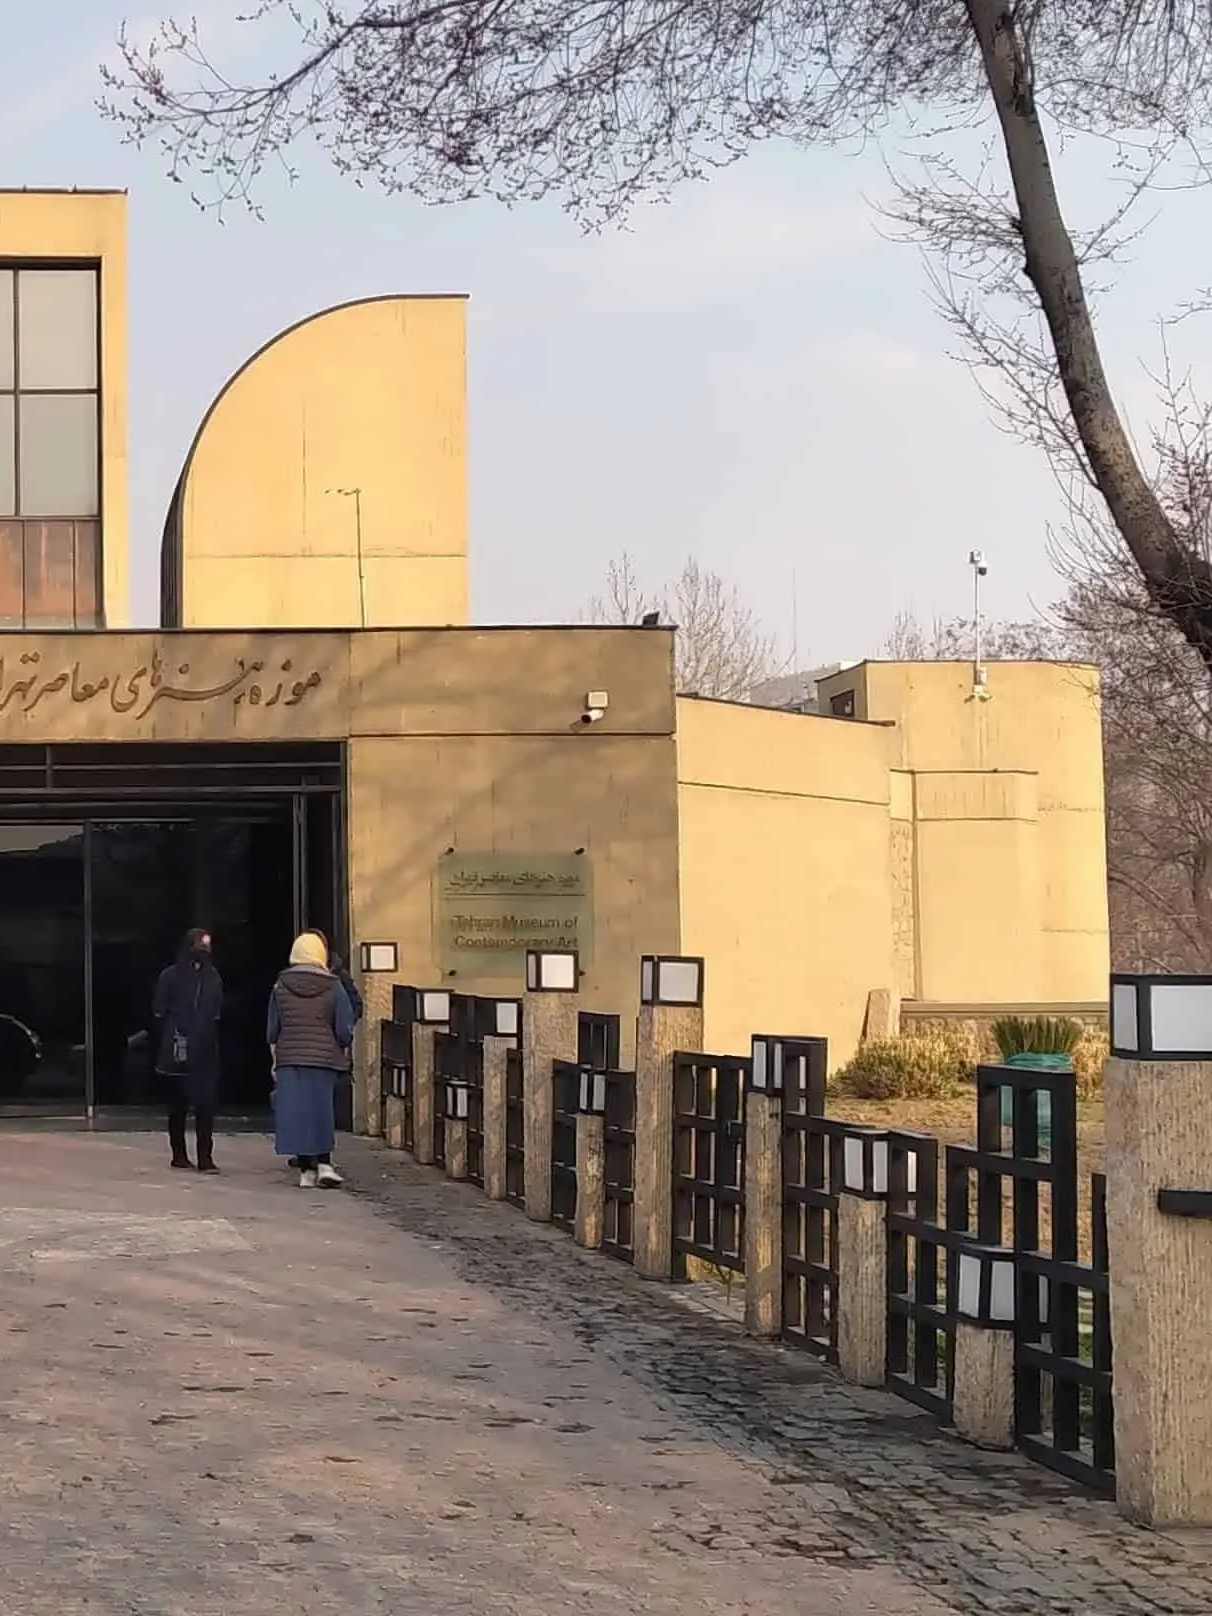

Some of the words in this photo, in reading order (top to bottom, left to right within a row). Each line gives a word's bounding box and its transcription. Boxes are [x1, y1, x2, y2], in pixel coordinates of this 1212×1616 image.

[23, 661, 110, 713] معاصر
[452, 914, 499, 930] Tehran
[502, 915, 560, 929] Museum
[564, 915, 578, 929] of
[454, 935, 554, 950] Contemporary
[556, 936, 578, 949] Art
